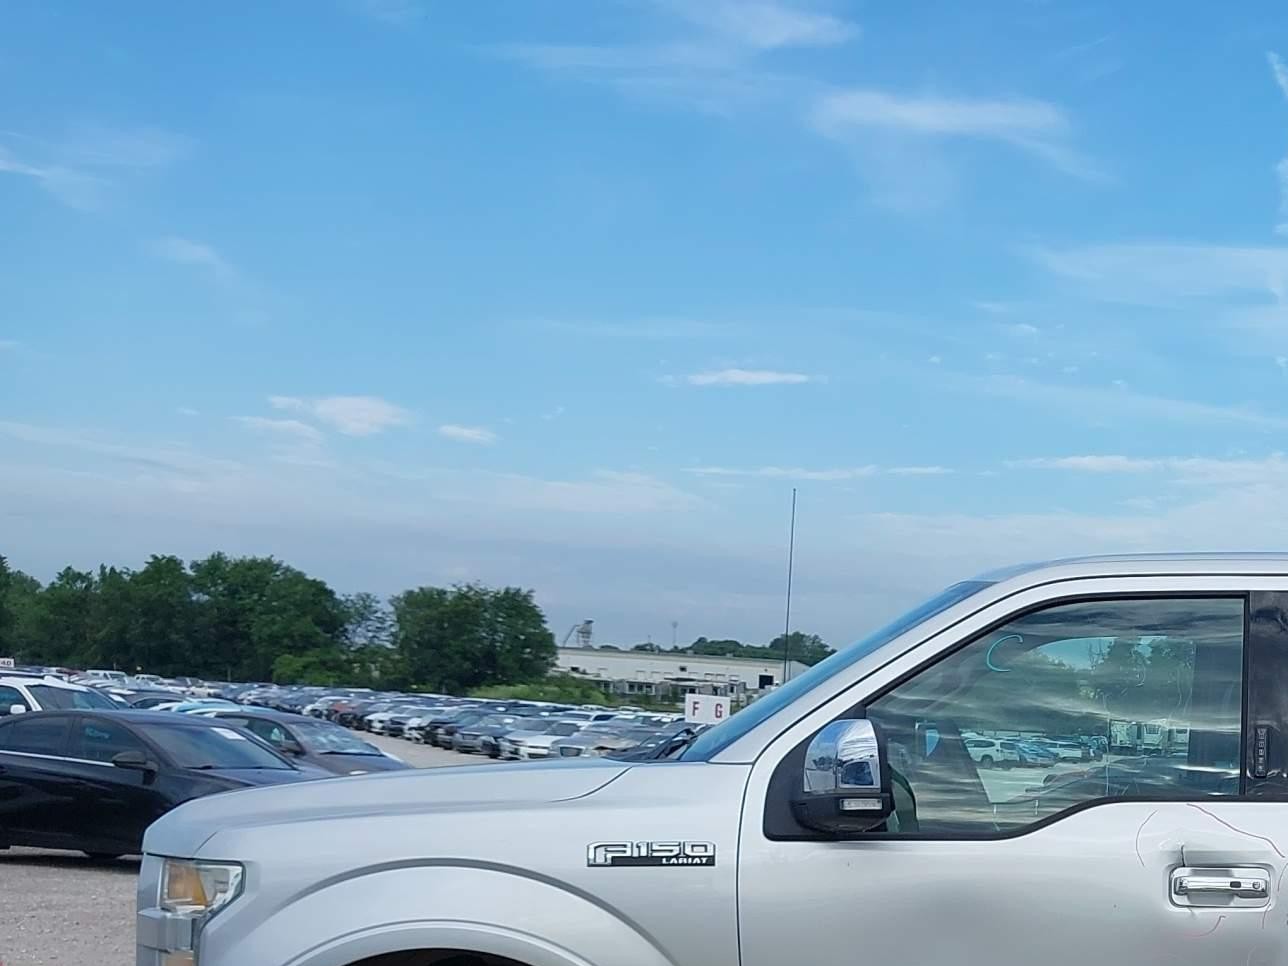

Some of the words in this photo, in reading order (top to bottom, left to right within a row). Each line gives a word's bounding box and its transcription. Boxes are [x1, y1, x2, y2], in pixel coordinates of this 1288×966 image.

[692, 701, 700, 717] F
[715, 703, 723, 719] G
[661, 857, 708, 865] LARIAT
